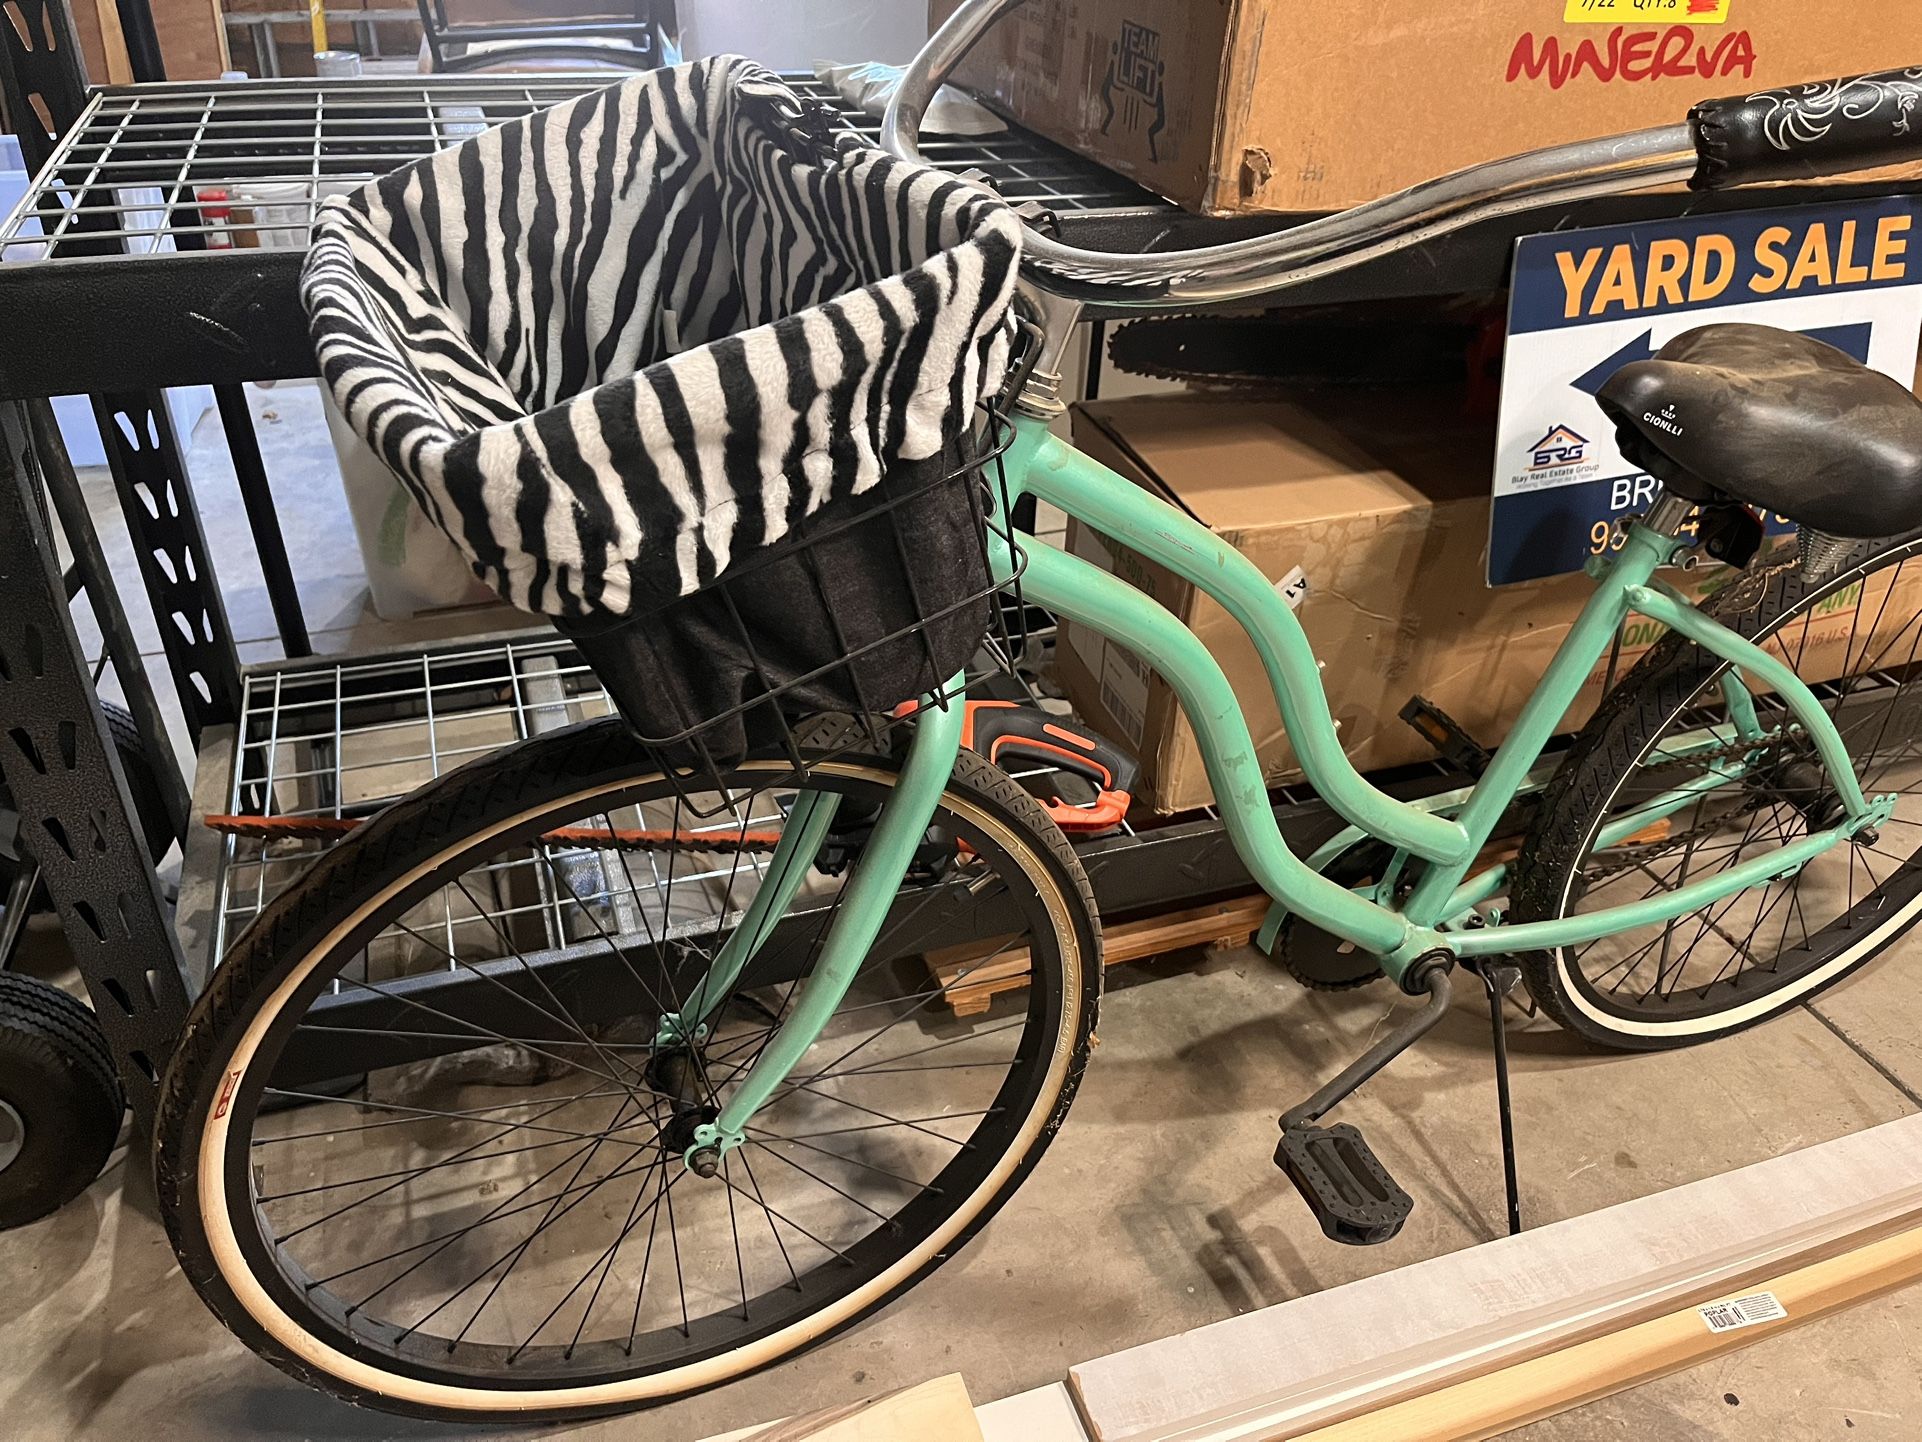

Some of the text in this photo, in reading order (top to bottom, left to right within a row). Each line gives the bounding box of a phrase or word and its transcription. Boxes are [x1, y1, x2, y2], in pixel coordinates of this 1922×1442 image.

[1122, 23, 1160, 63] TEAM
[1506, 25, 1756, 89] MINERVA
[1119, 50, 1157, 96] LIFT
[1554, 215, 1912, 318] YARD SALE
[1643, 412, 1683, 436] CIONLLI
[1530, 471, 1547, 480] Real
[1549, 467, 1574, 478] Estate
[1575, 463, 1600, 474] Group
[1610, 475, 1663, 510] BR
[1285, 577, 1307, 599] A1
